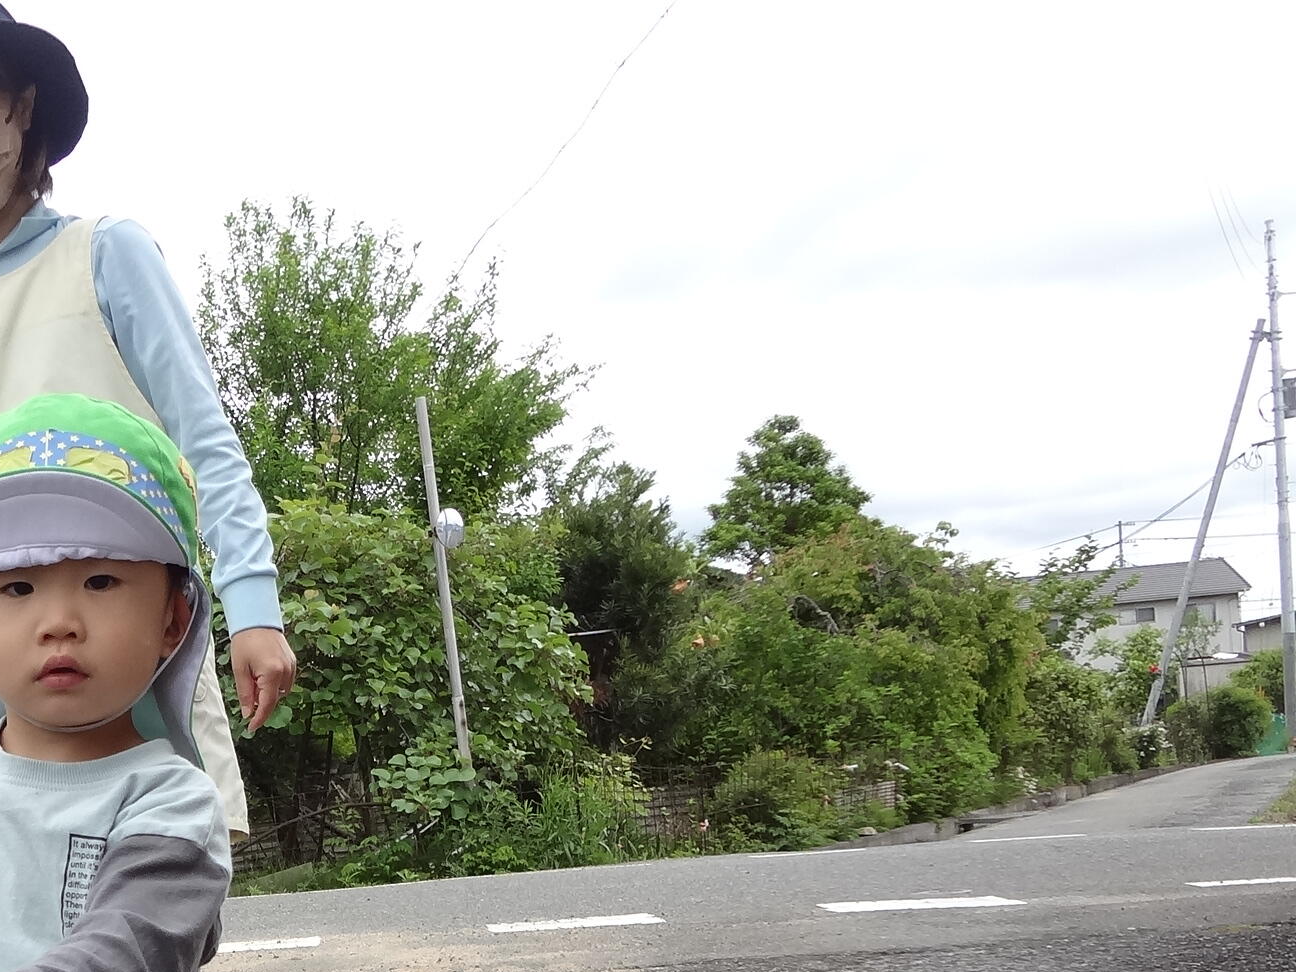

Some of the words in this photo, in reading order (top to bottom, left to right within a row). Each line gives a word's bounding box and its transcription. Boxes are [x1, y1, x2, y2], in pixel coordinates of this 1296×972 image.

[73, 840, 79, 849] It
[80, 841, 104, 852] alway
[72, 851, 102, 861] imposs
[71, 861, 86, 869] until
[78, 871, 88, 880] the
[67, 881, 91, 890] difficul
[65, 891, 88, 900] opport
[65, 900, 83, 910] Then
